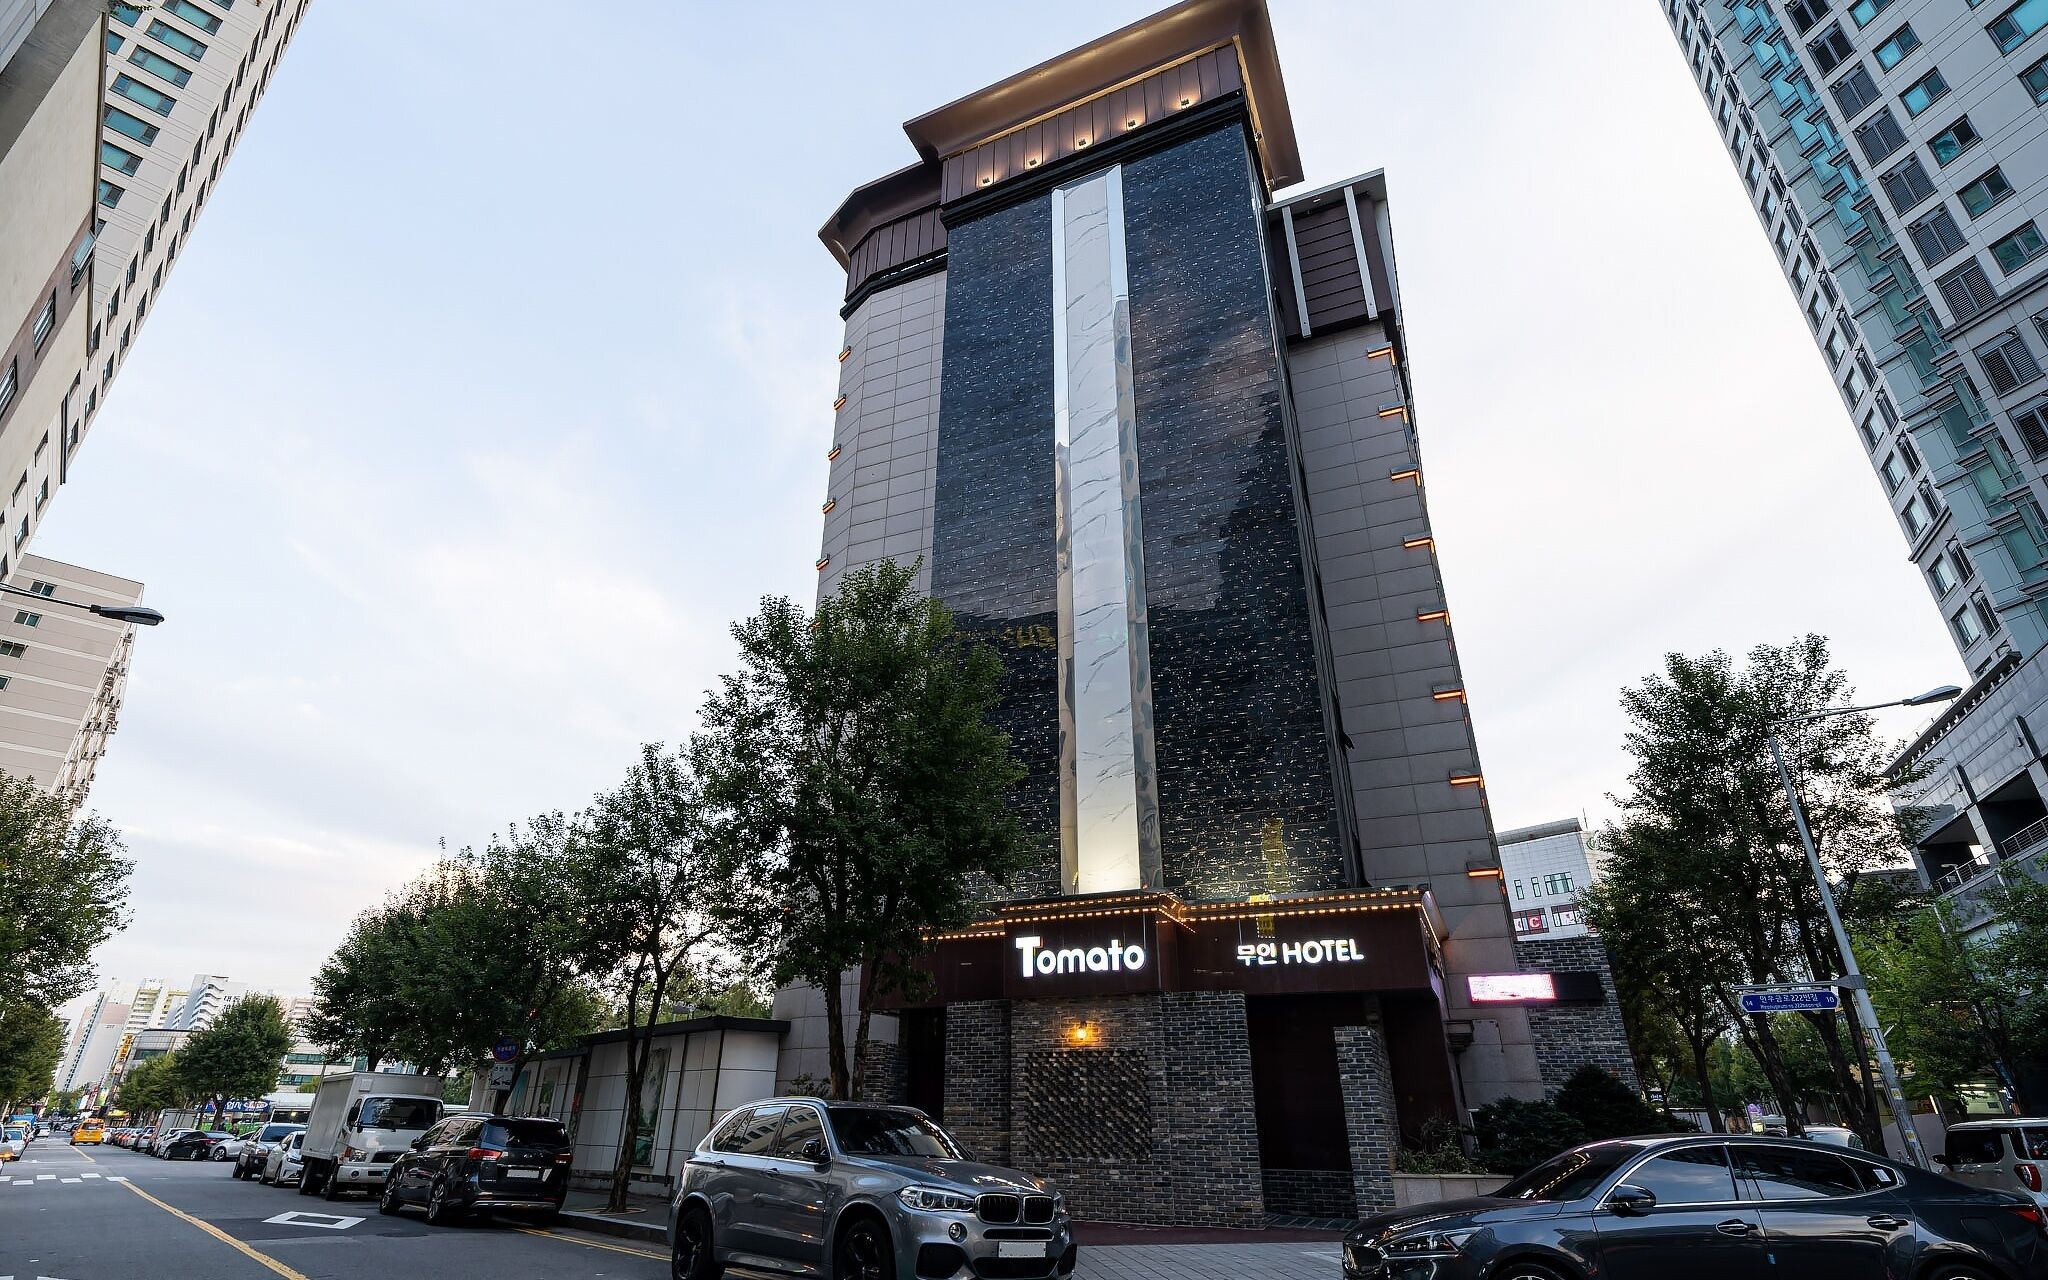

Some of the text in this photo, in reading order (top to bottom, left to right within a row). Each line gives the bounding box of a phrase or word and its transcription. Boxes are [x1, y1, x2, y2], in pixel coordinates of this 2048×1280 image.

[1015, 935, 1146, 978] Tomato
[1236, 938, 1366, 967] 무인 HOTEL
